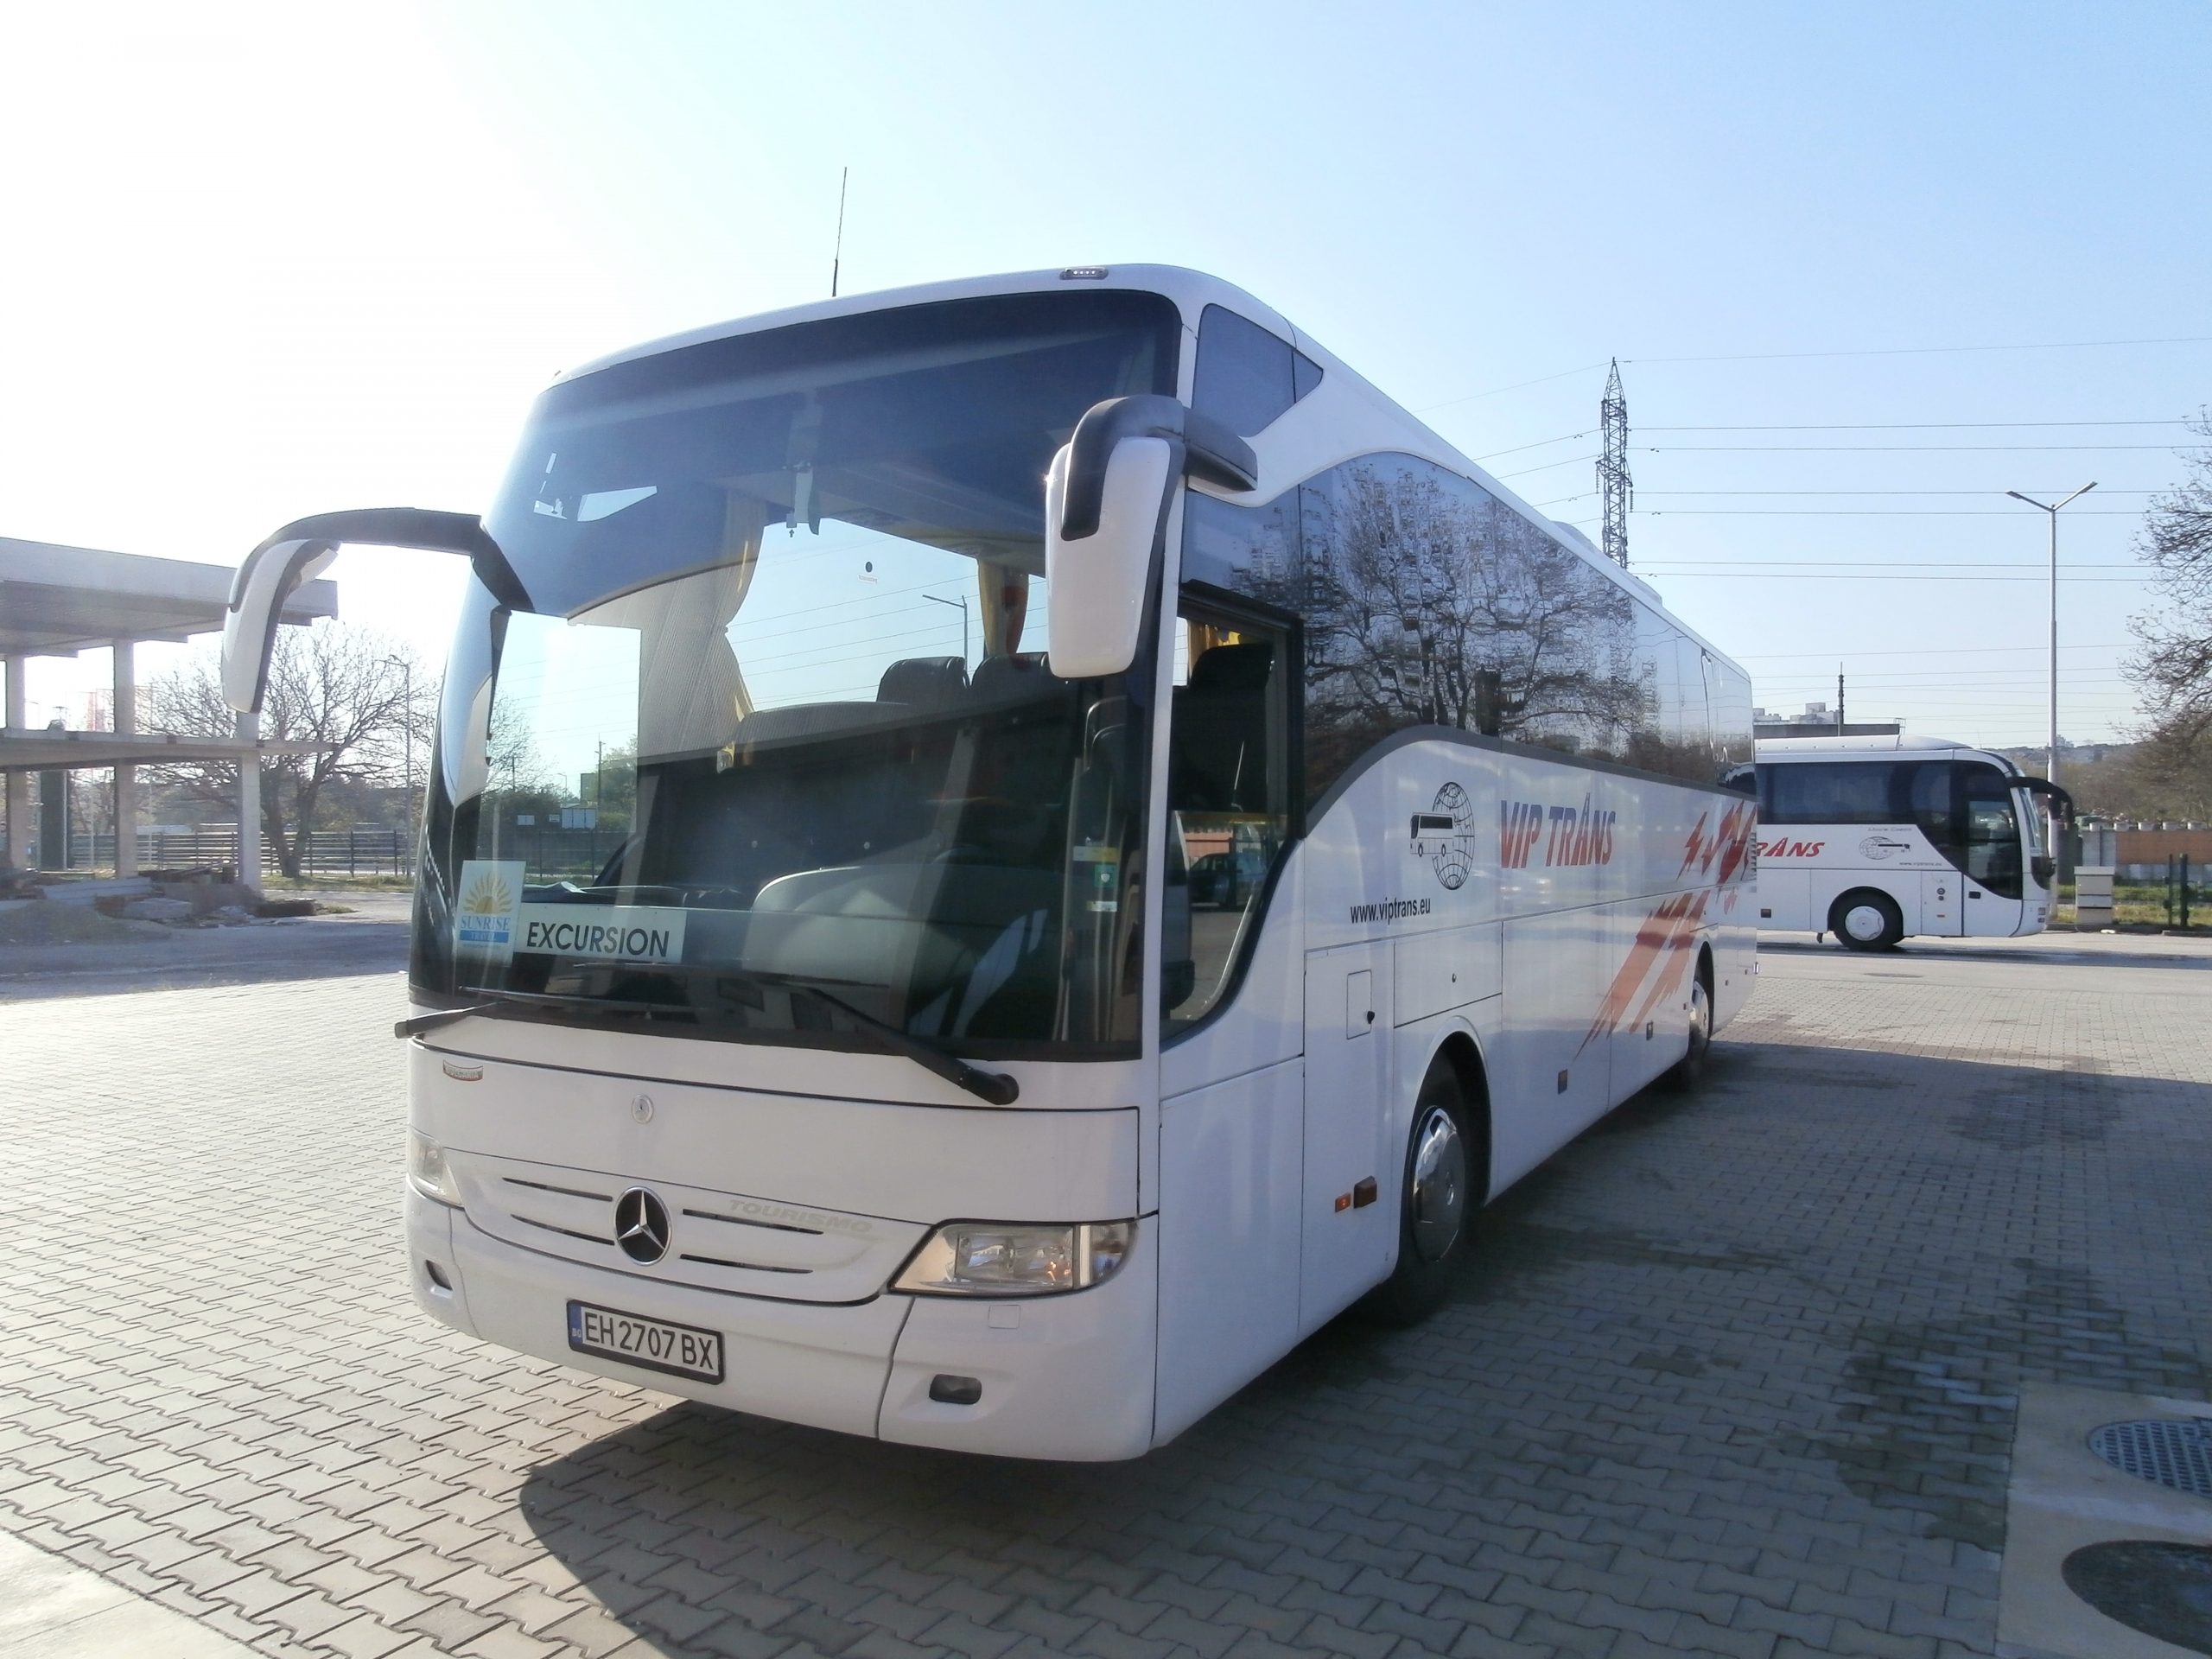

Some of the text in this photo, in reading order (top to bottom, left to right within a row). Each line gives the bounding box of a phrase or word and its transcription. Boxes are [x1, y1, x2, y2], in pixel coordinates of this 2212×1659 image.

[1501, 792, 1617, 869] VIP TRANS
[1756, 836, 1825, 857] RANS
[461, 915, 512, 931] SUNRISE
[1350, 896, 1431, 925] www.viptrans.eu
[526, 921, 670, 957] EXCURSION
[730, 1199, 873, 1233] TOURISMO
